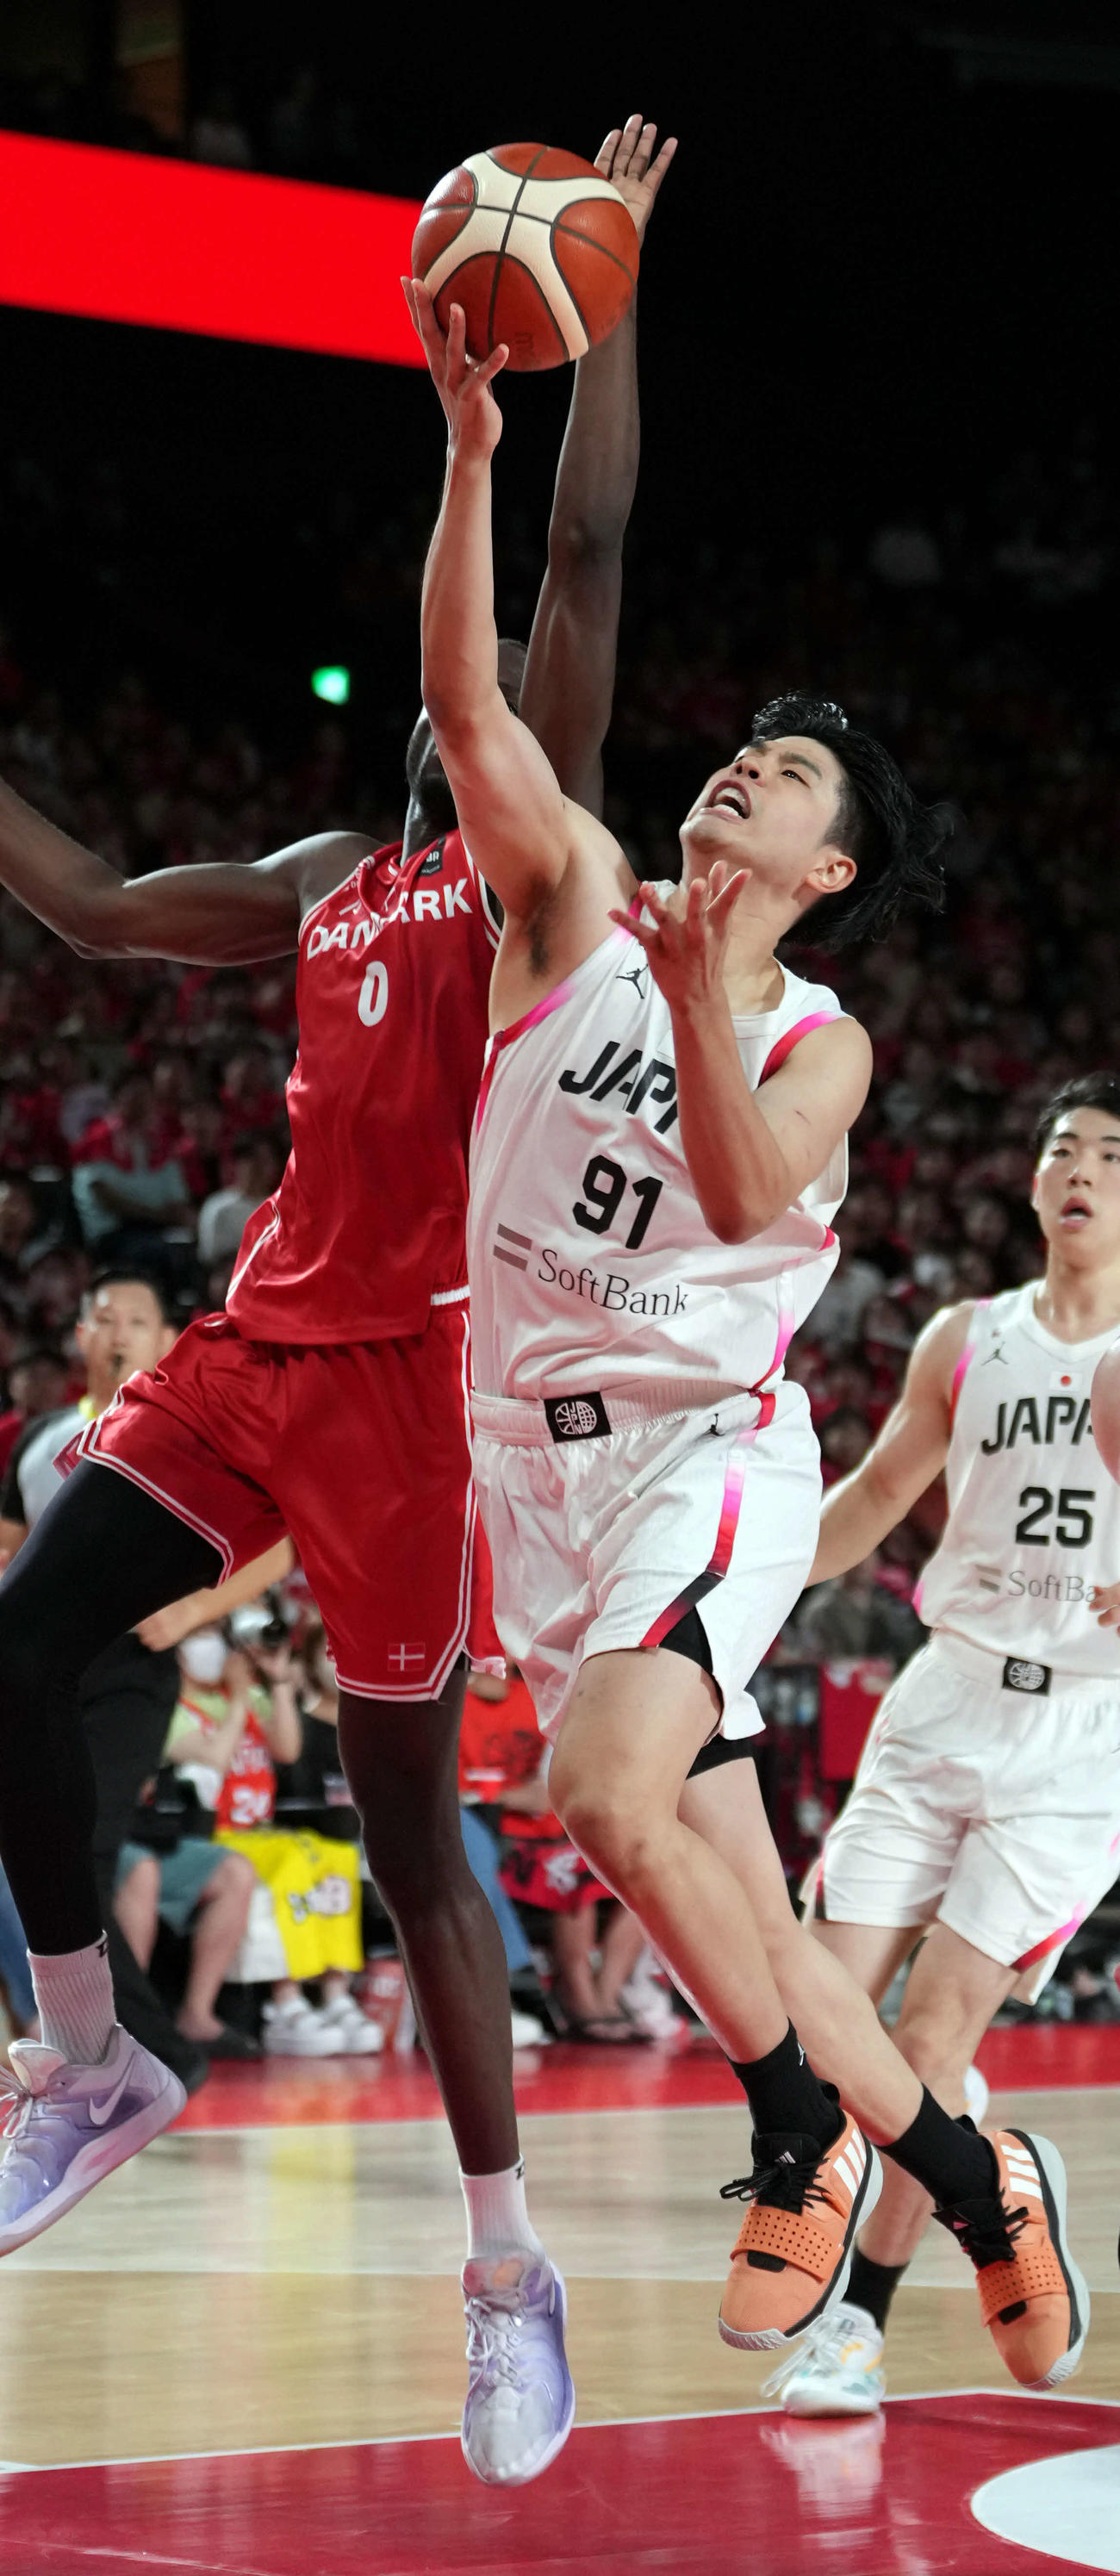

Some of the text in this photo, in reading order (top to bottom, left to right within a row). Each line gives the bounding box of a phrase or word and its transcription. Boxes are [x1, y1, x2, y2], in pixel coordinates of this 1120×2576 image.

[358, 961, 388, 1027] 0
[558, 1041, 678, 1135] JAP
[572, 1154, 663, 1250] 91
[538, 1249, 689, 1316] SoftBank
[1016, 1486, 1096, 1549] 25
[1007, 1571, 1096, 1602] SoftBa
